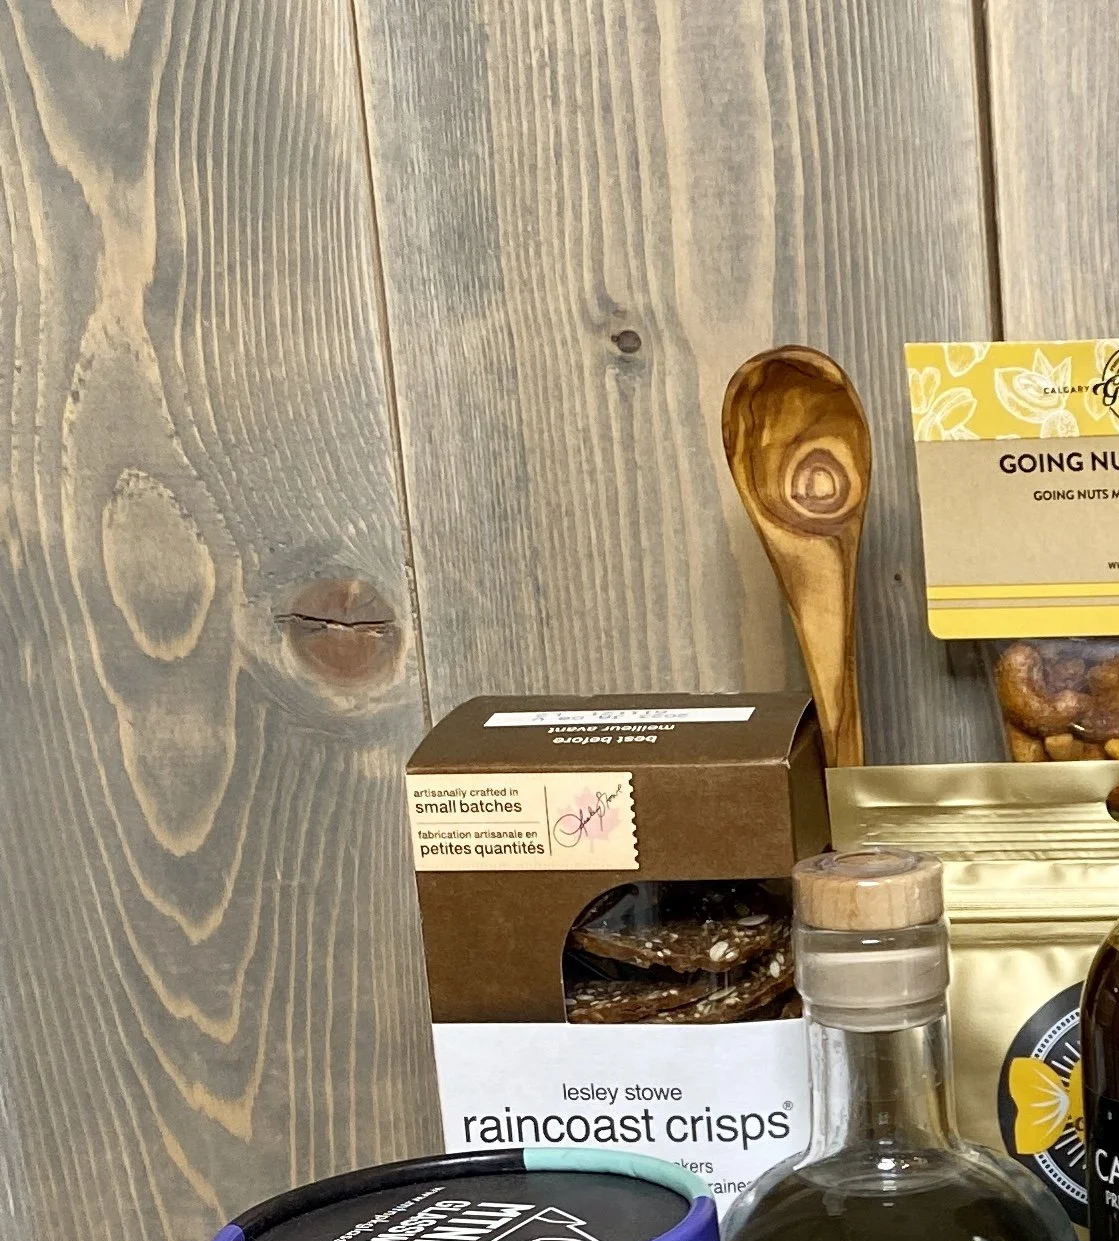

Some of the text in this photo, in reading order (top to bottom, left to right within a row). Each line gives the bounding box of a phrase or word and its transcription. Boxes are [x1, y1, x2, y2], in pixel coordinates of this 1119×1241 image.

[1043, 385, 1090, 395] CALGARY
[999, 452, 1084, 474] GOING
[1033, 489, 1075, 501] GOING
[1077, 488, 1109, 500] NUTS
[601, 724, 676, 732] meilleur
[552, 735, 658, 745] best before
[413, 788, 519, 798] artisanally crafted in
[415, 799, 522, 814] small batches
[418, 830, 472, 840] fabrication
[474, 830, 523, 839] artisanale
[420, 841, 545, 858] petites quantités
[563, 1083, 682, 1105] lesley stowe
[463, 1107, 656, 1143] raincoast
